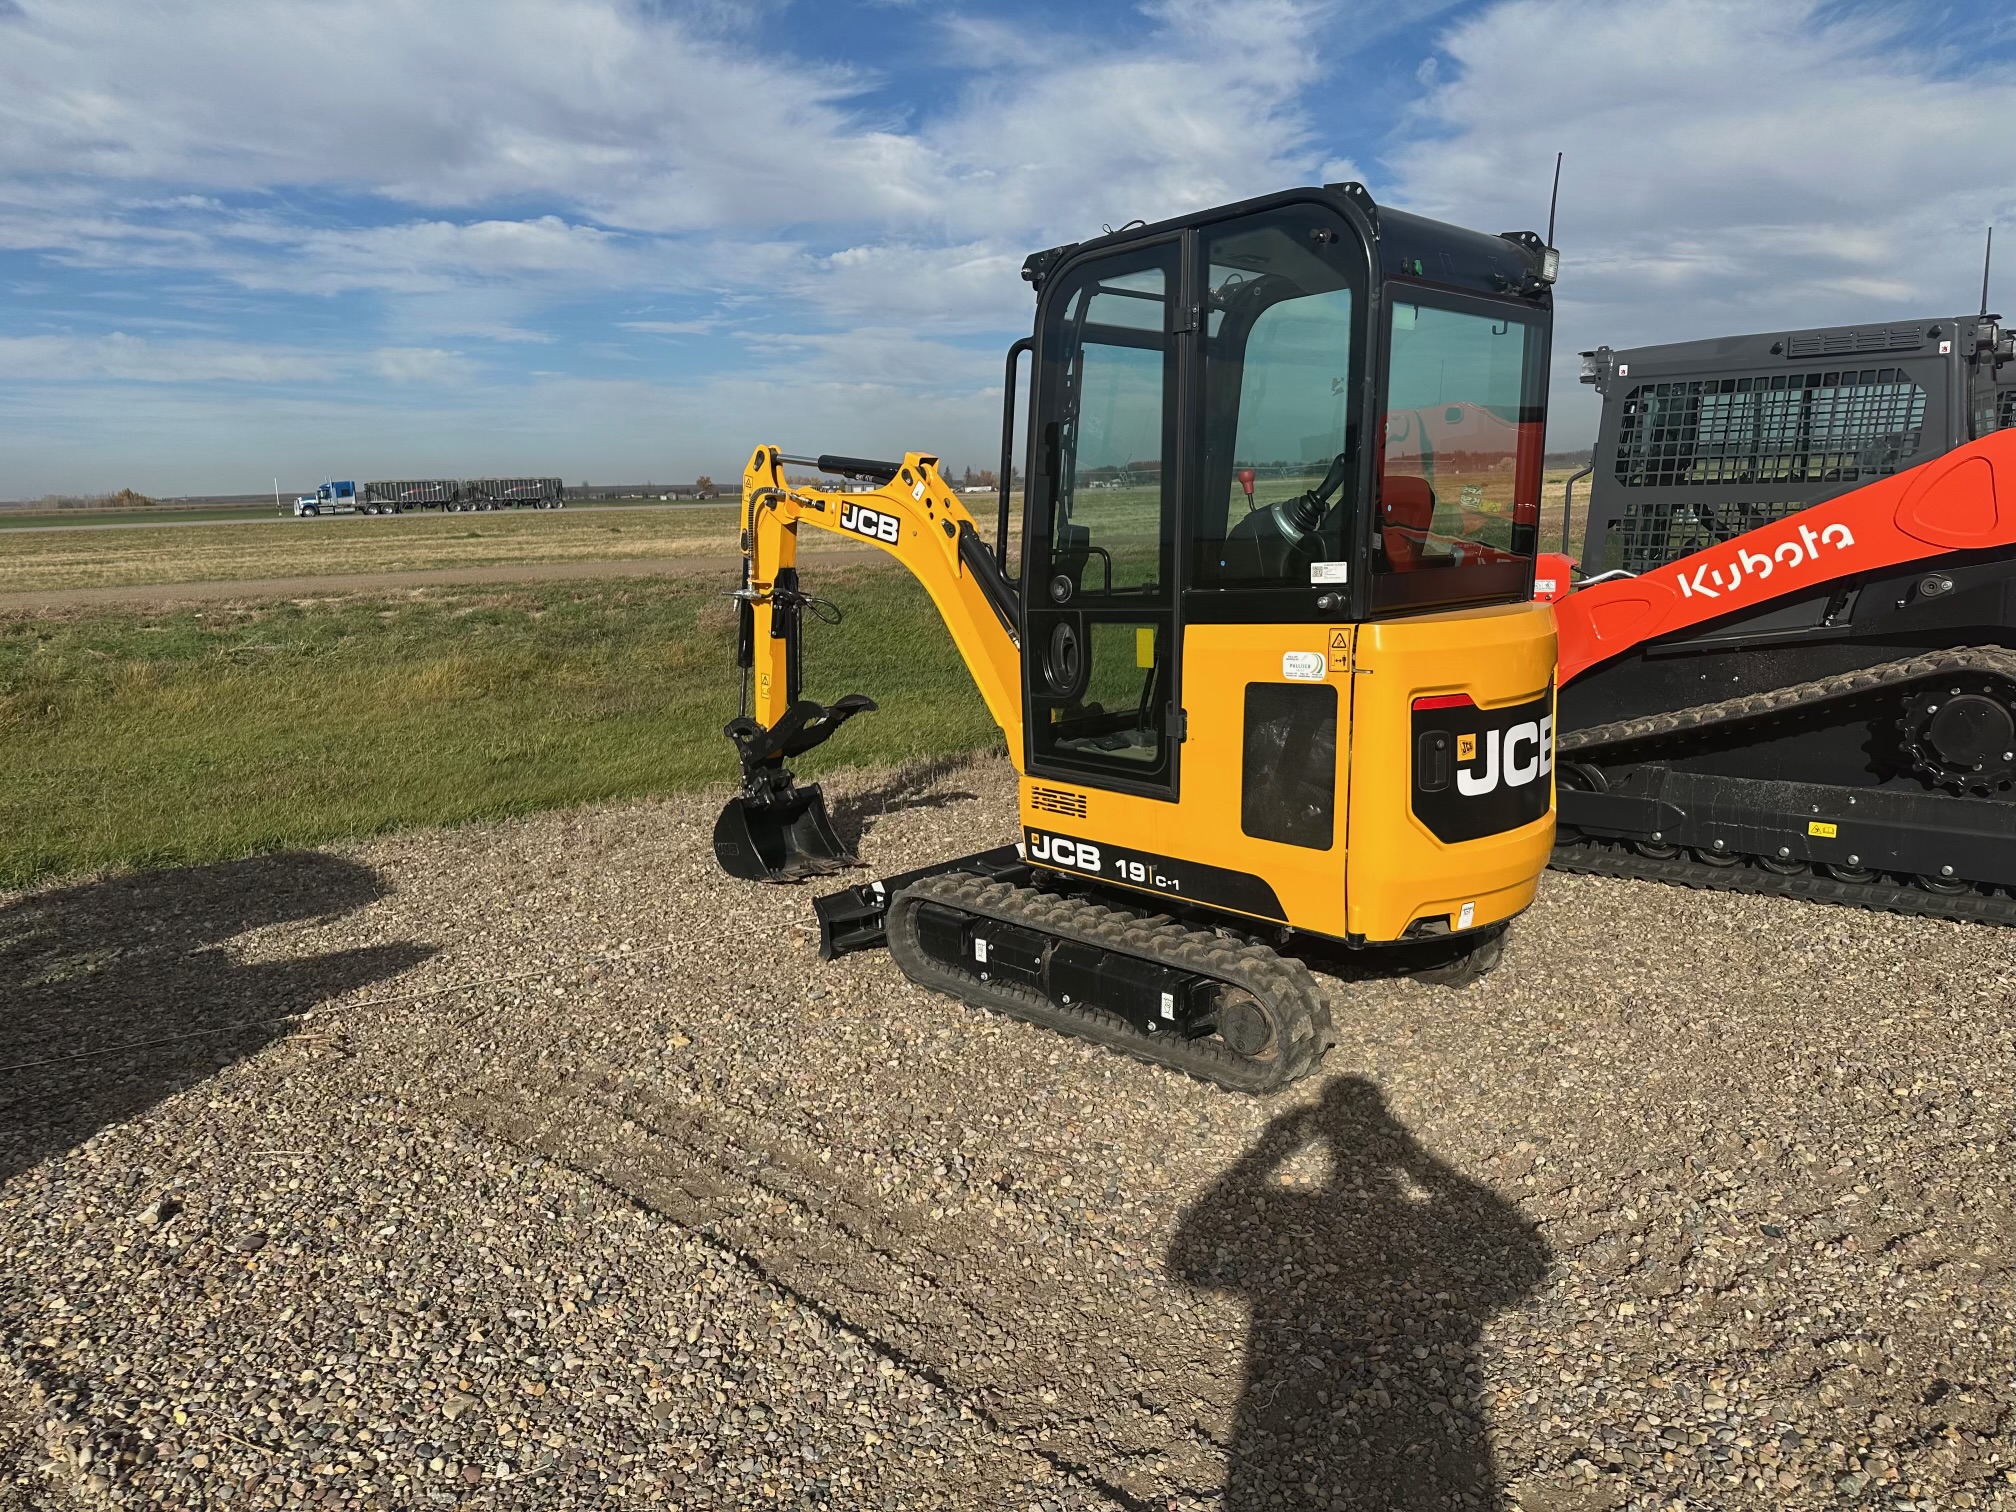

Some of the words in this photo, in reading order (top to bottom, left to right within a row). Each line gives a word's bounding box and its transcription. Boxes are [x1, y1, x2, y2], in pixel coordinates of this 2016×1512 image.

[841, 505, 899, 543] JCB
[1677, 524, 1855, 598] Kubota
[1031, 835, 1102, 872] JCB
[1115, 859, 1146, 882] 19
